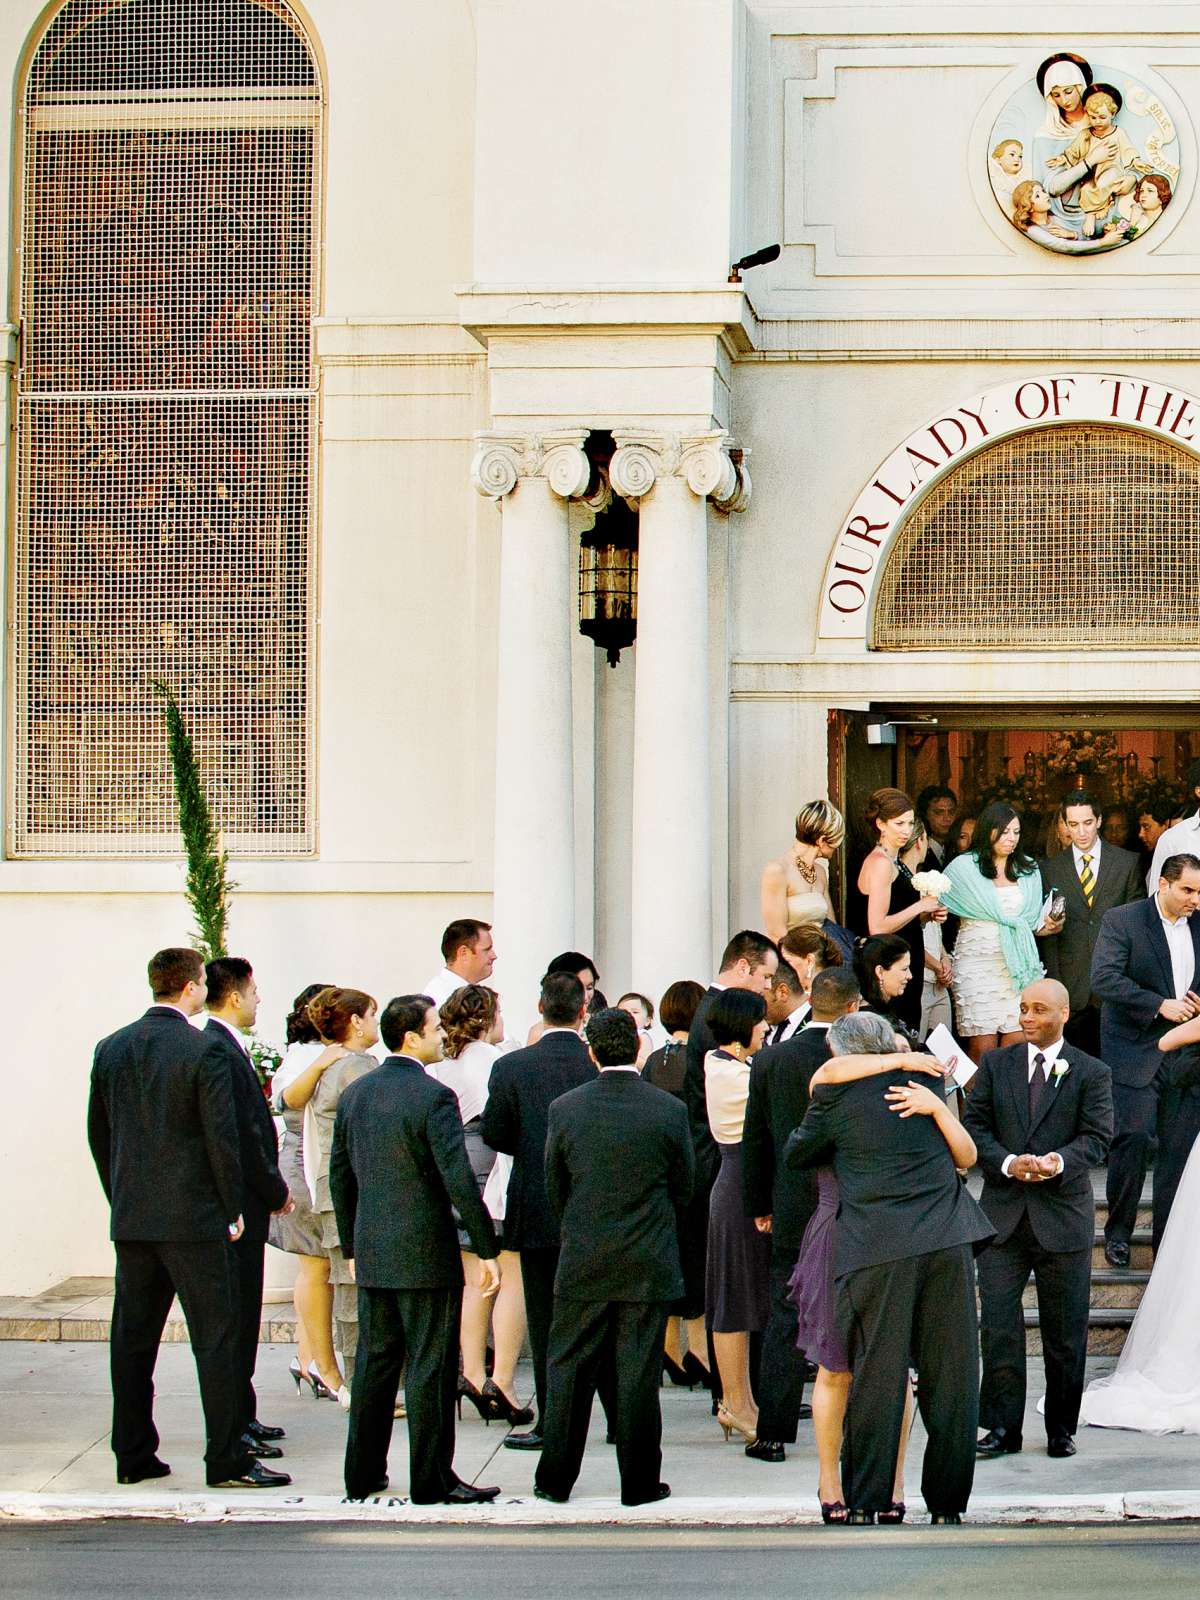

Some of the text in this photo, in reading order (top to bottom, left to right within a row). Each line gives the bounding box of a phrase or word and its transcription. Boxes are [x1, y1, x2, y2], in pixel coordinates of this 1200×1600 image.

[828, 514, 890, 614] OUR
[873, 395, 989, 507] LADY
[1014, 378, 1075, 419] OF
